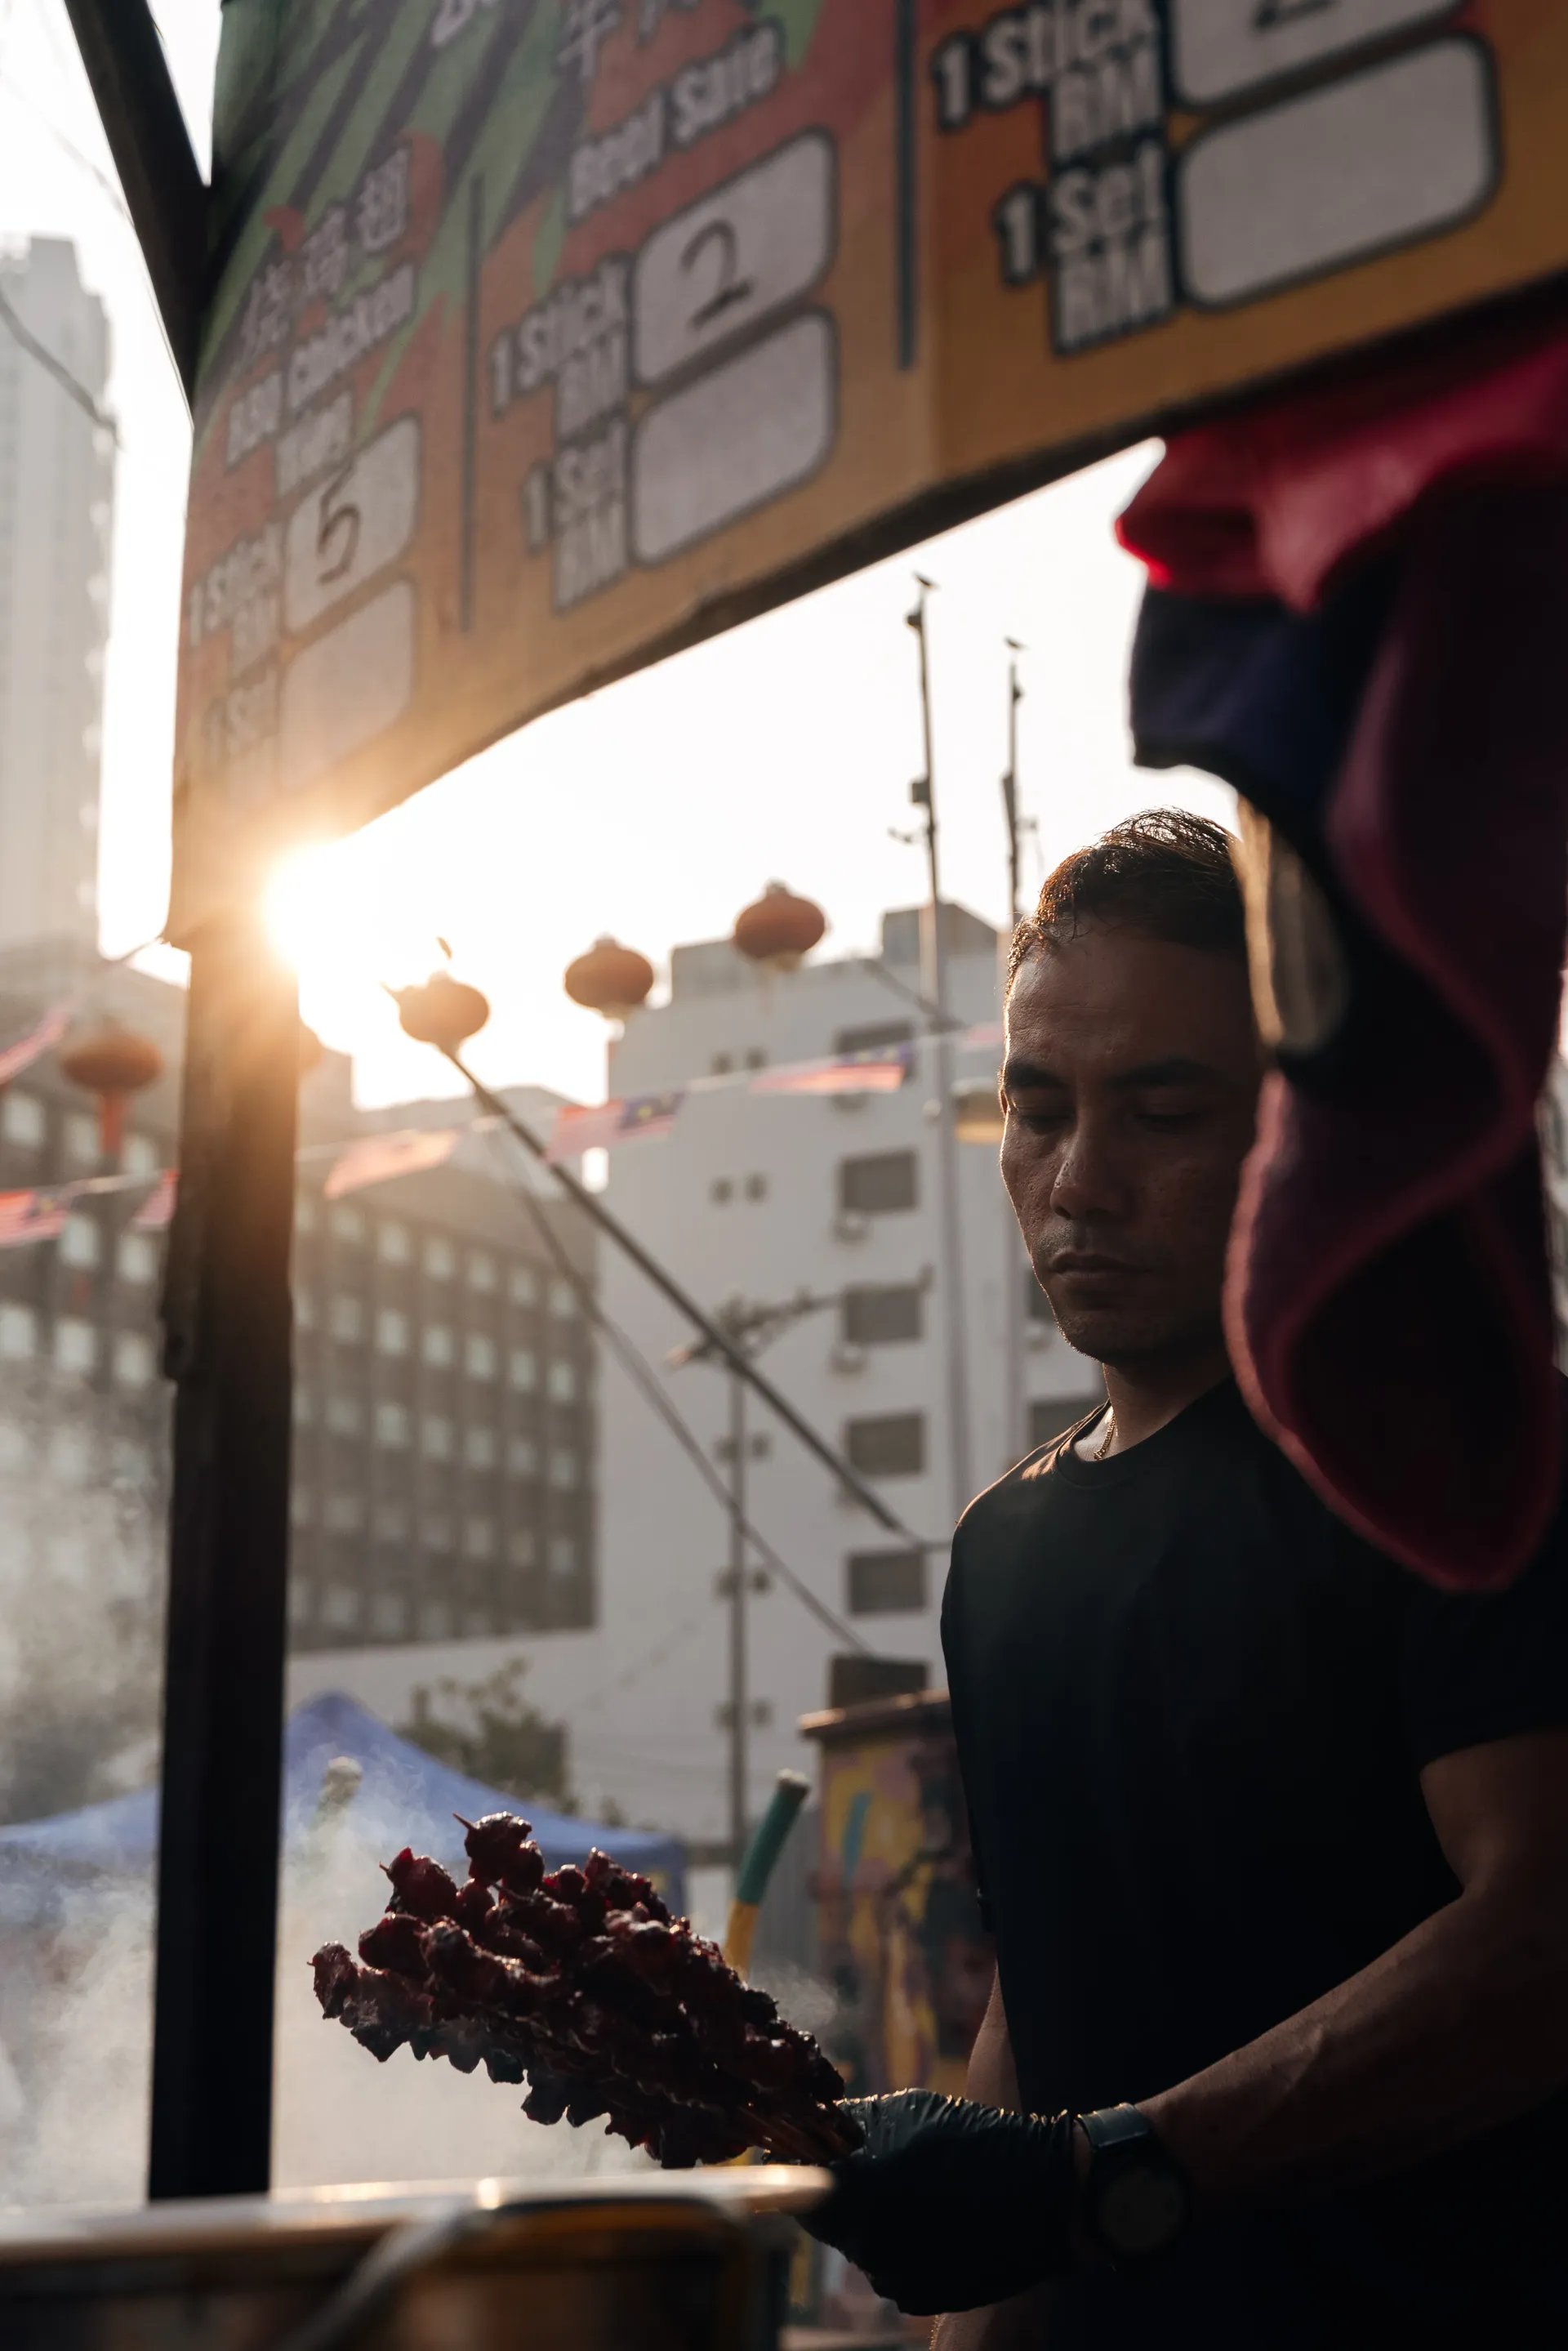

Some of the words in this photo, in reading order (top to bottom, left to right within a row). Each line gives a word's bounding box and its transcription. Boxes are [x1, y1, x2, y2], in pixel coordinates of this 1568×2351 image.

[940, 43, 970, 123] 1
[681, 219, 755, 330] 2
[1001, 192, 1036, 279] 1
[492, 332, 514, 414] 1
[316, 461, 362, 585] 5
[526, 471, 548, 547] 1
